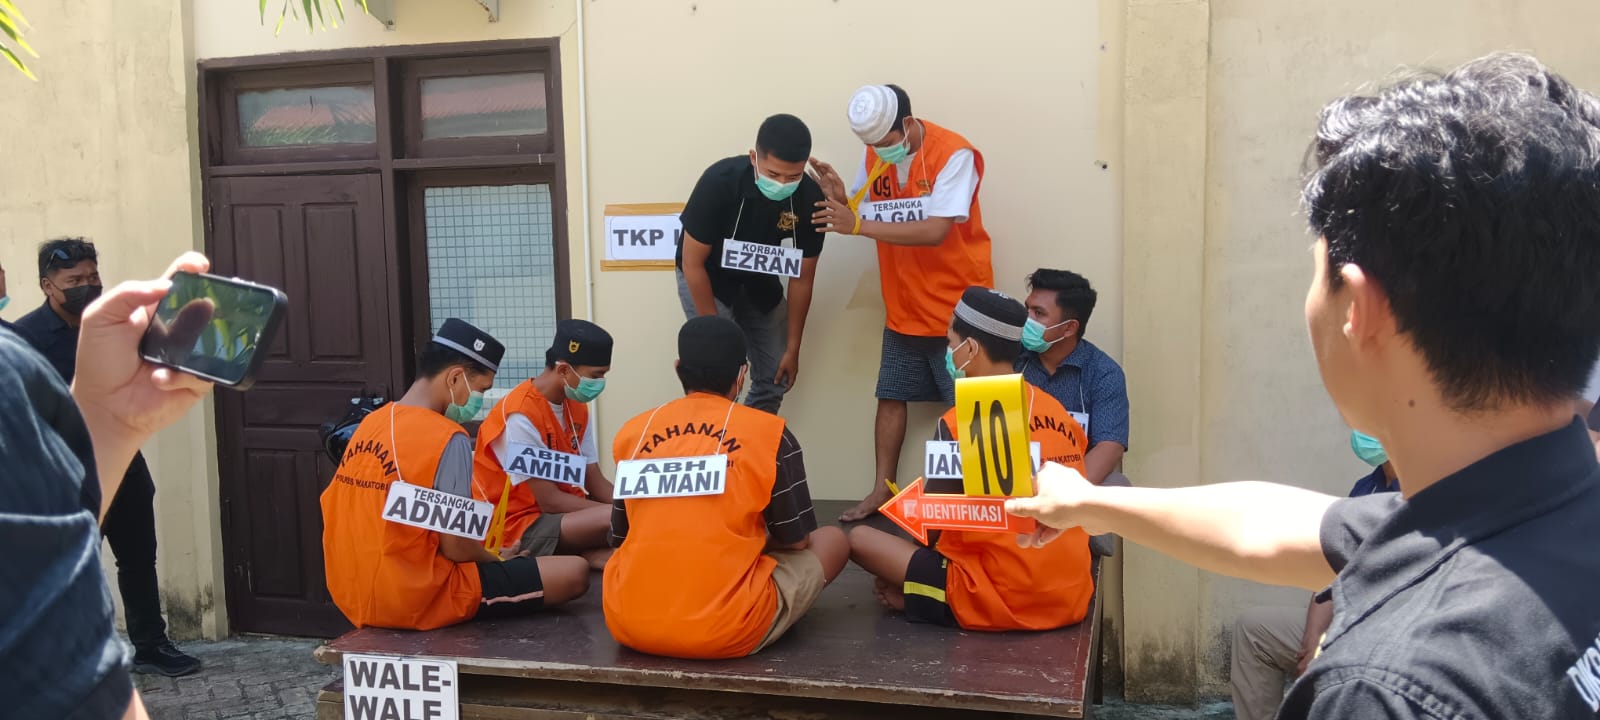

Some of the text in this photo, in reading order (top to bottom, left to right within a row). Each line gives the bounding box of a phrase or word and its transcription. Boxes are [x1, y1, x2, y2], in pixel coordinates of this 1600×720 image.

[873, 200, 922, 212] TERSANGKA
[613, 229, 664, 246] TKP
[742, 243, 785, 257] KORBAN
[724, 249, 800, 276] EZRAN
[639, 422, 741, 454] TAHANAN
[969, 400, 1014, 496] 10
[340, 440, 397, 476] TAHANAN
[520, 447, 570, 464] ABH
[639, 460, 706, 475] ABH
[508, 456, 582, 483] AMIN
[619, 470, 720, 496] LA MANI
[414, 488, 475, 512] TERSANGKA
[922, 503, 1002, 522] IDENTIFIKASI
[386, 496, 488, 537] ADNAN
[349, 660, 451, 692] WALE-
